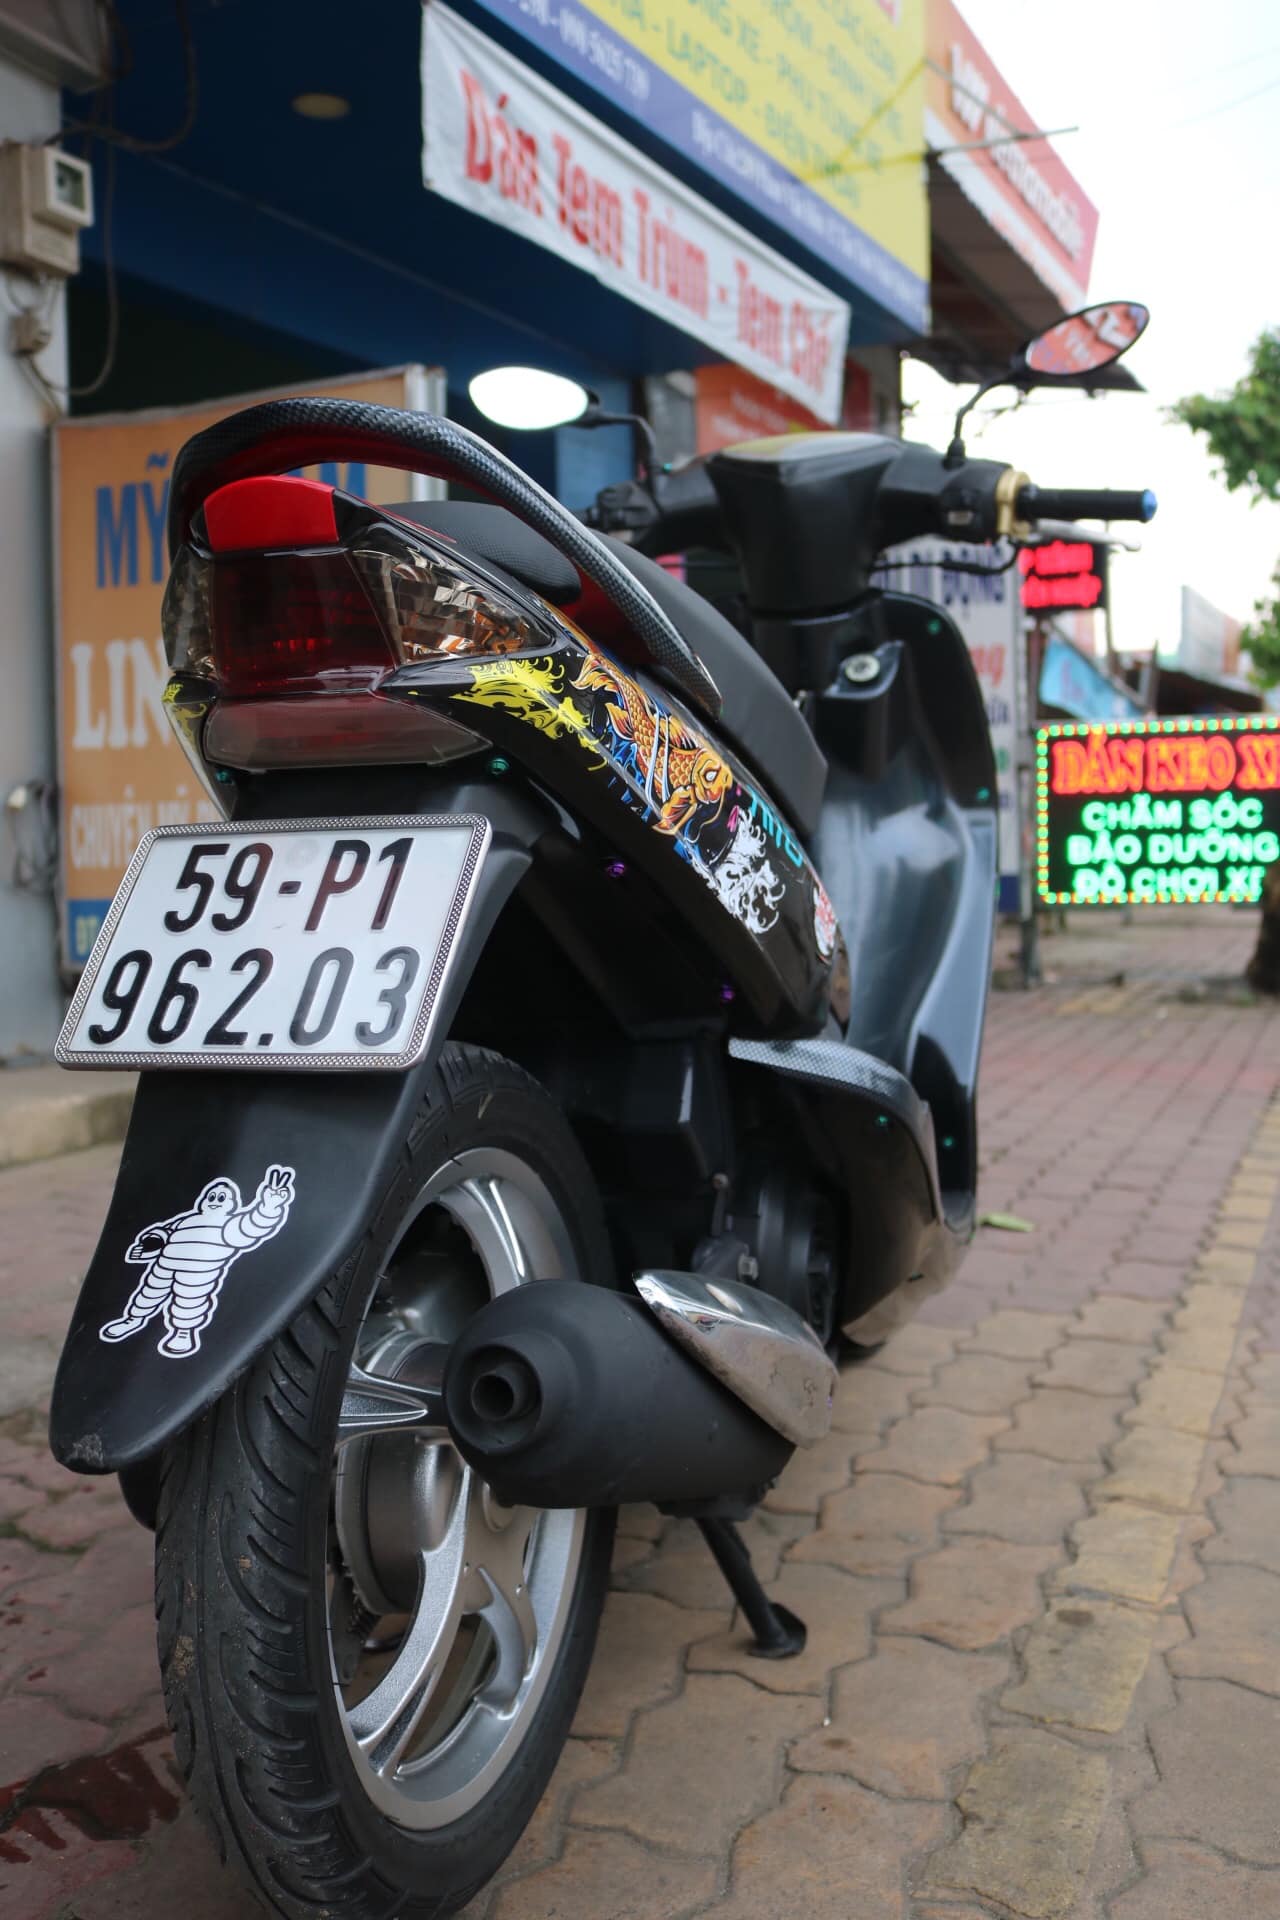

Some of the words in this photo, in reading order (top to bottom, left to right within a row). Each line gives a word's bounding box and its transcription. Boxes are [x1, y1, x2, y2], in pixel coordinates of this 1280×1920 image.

[461, 68, 543, 218] Dán
[552, 132, 624, 269] Tem
[1082, 793, 1182, 831] CHĂM
[1189, 791, 1263, 829] SÓC
[1067, 828, 1142, 864] BẢO
[1148, 827, 1279, 864] DƯỠNG
[163, 837, 415, 934] 59-P1
[1131, 867, 1219, 897] CHƠI
[88, 947, 421, 1047] 962.03
